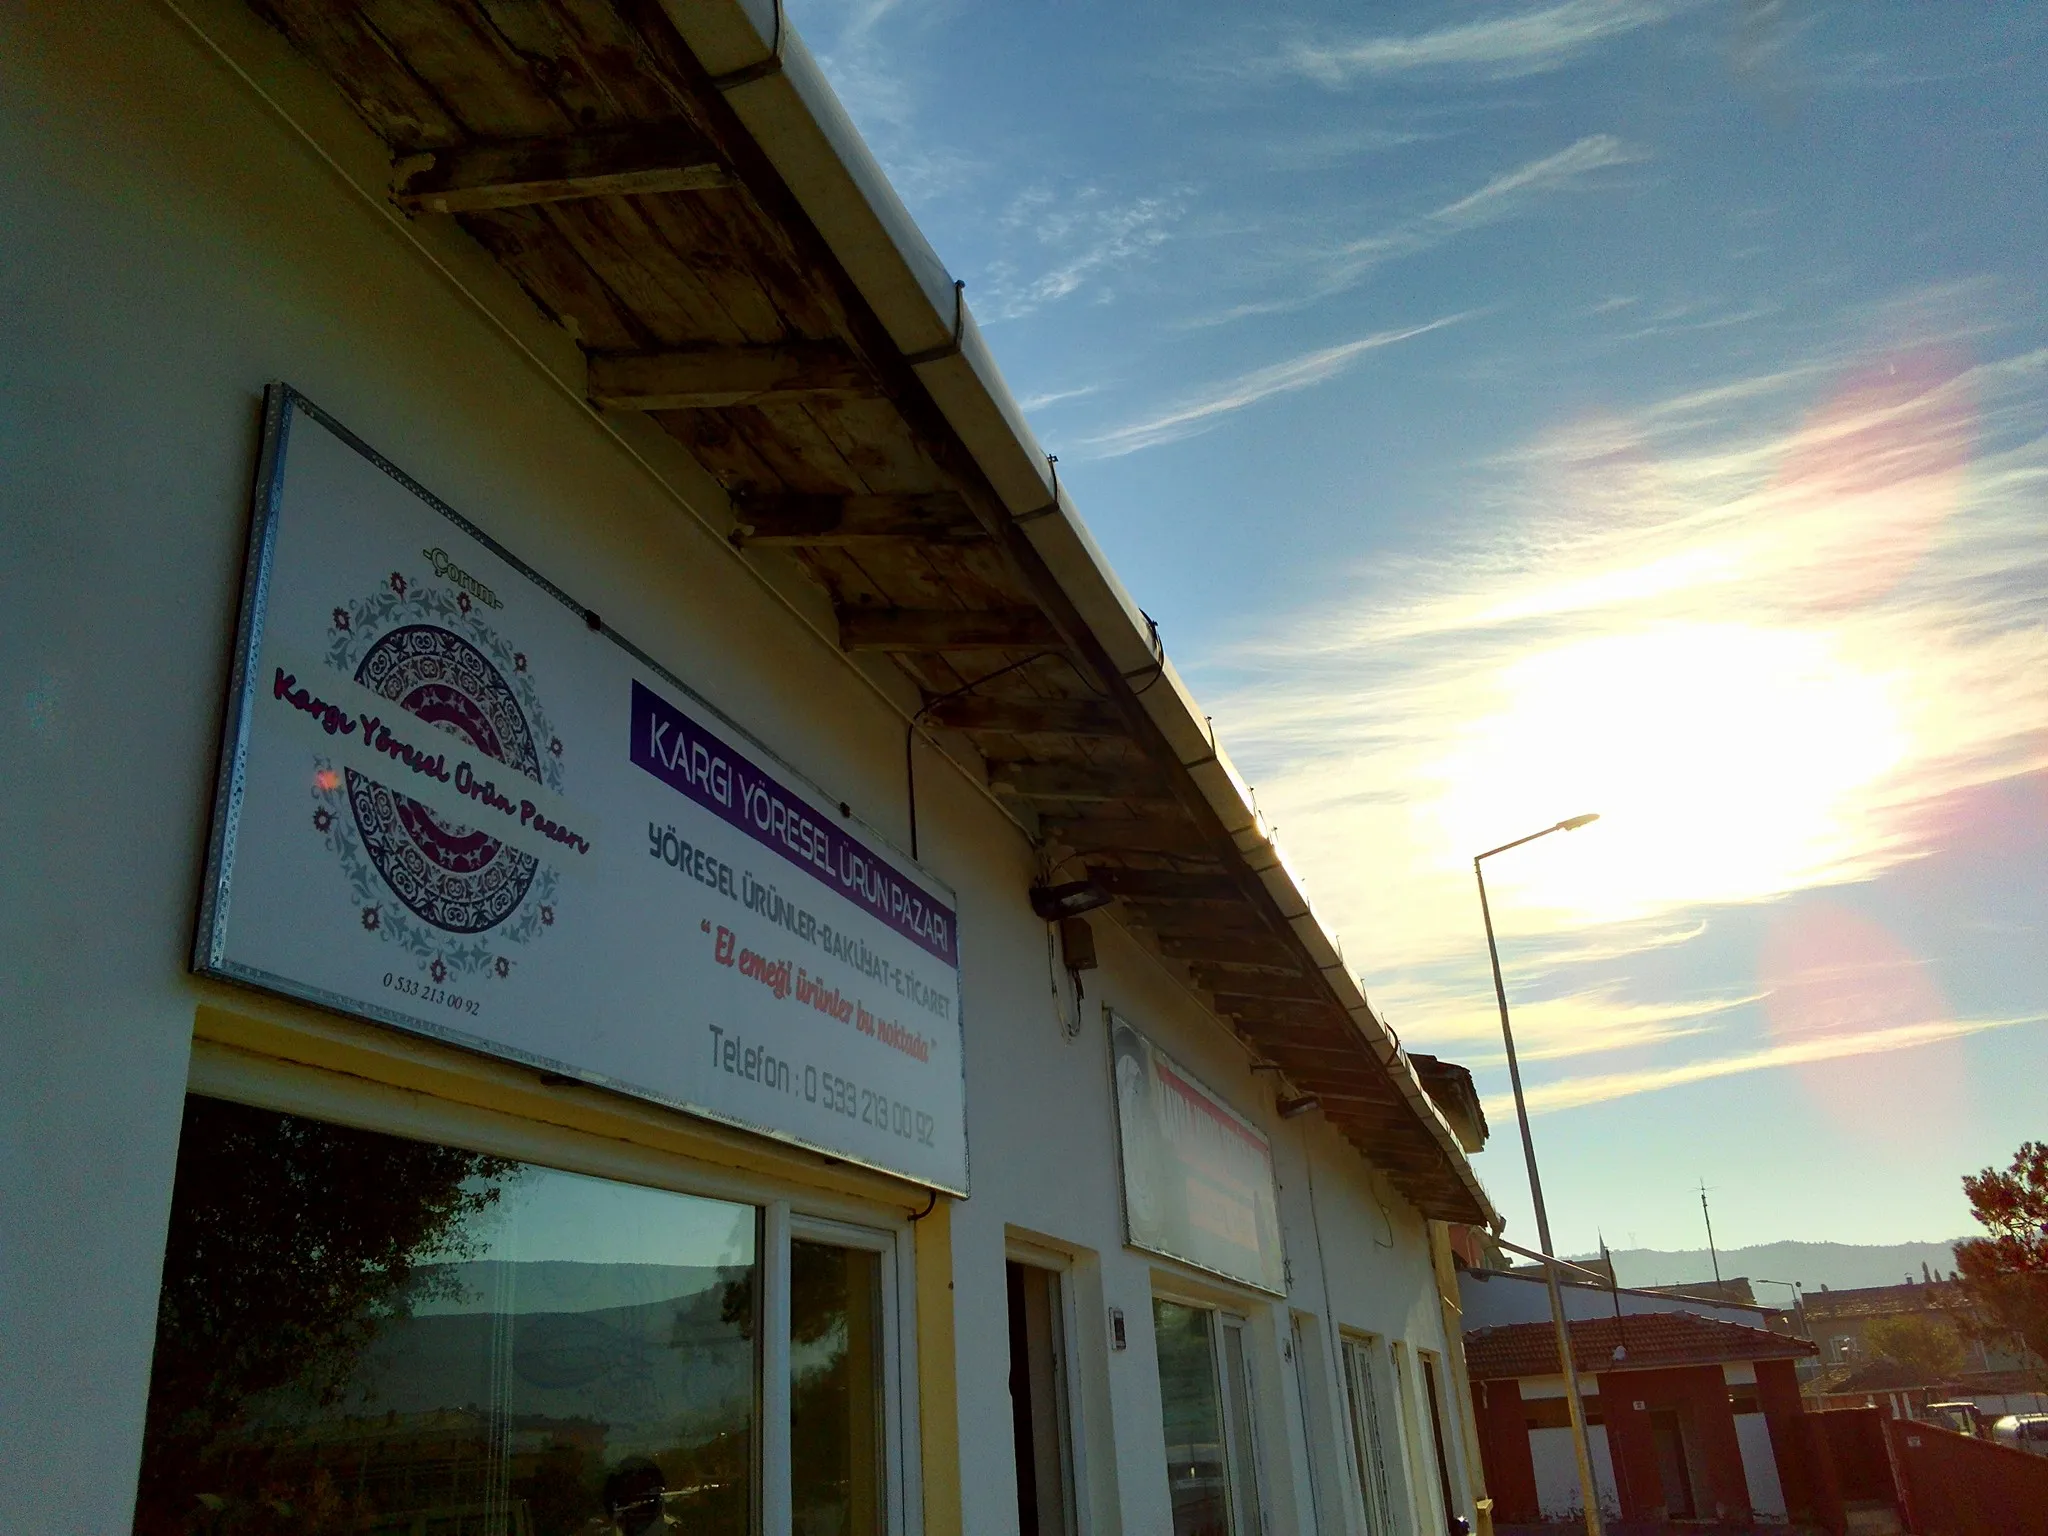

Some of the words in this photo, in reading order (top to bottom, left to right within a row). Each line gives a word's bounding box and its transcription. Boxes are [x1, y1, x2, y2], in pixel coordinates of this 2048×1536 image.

[274, 667, 356, 734] Kargı
[360, 714, 450, 783] Yöresel
[455, 761, 517, 815] Ürün
[520, 800, 590, 855] Pazarı
[649, 821, 738, 901] YÖRESEL
[651, 712, 732, 808] KARGI
[738, 773, 836, 876] YÖRESEL
[839, 842, 889, 913] ÜRÜN
[892, 883, 948, 952] PAZARI
[383, 972, 393, 988] 0
[394, 976, 419, 996] 533
[421, 986, 445, 1004] 213
[447, 994, 463, 1010] 00
[465, 1000, 480, 1016] 92
[738, 948, 793, 1000] emeği
[796, 967, 854, 1025] ürünler
[856, 1000, 876, 1037] bu
[709, 1024, 790, 1094] Telefon
[804, 1064, 817, 1103] 0
[822, 1071, 857, 1119] 533
[861, 1088, 888, 1131] 213
[892, 1101, 912, 1139] 00
[915, 1110, 935, 1148] 92
